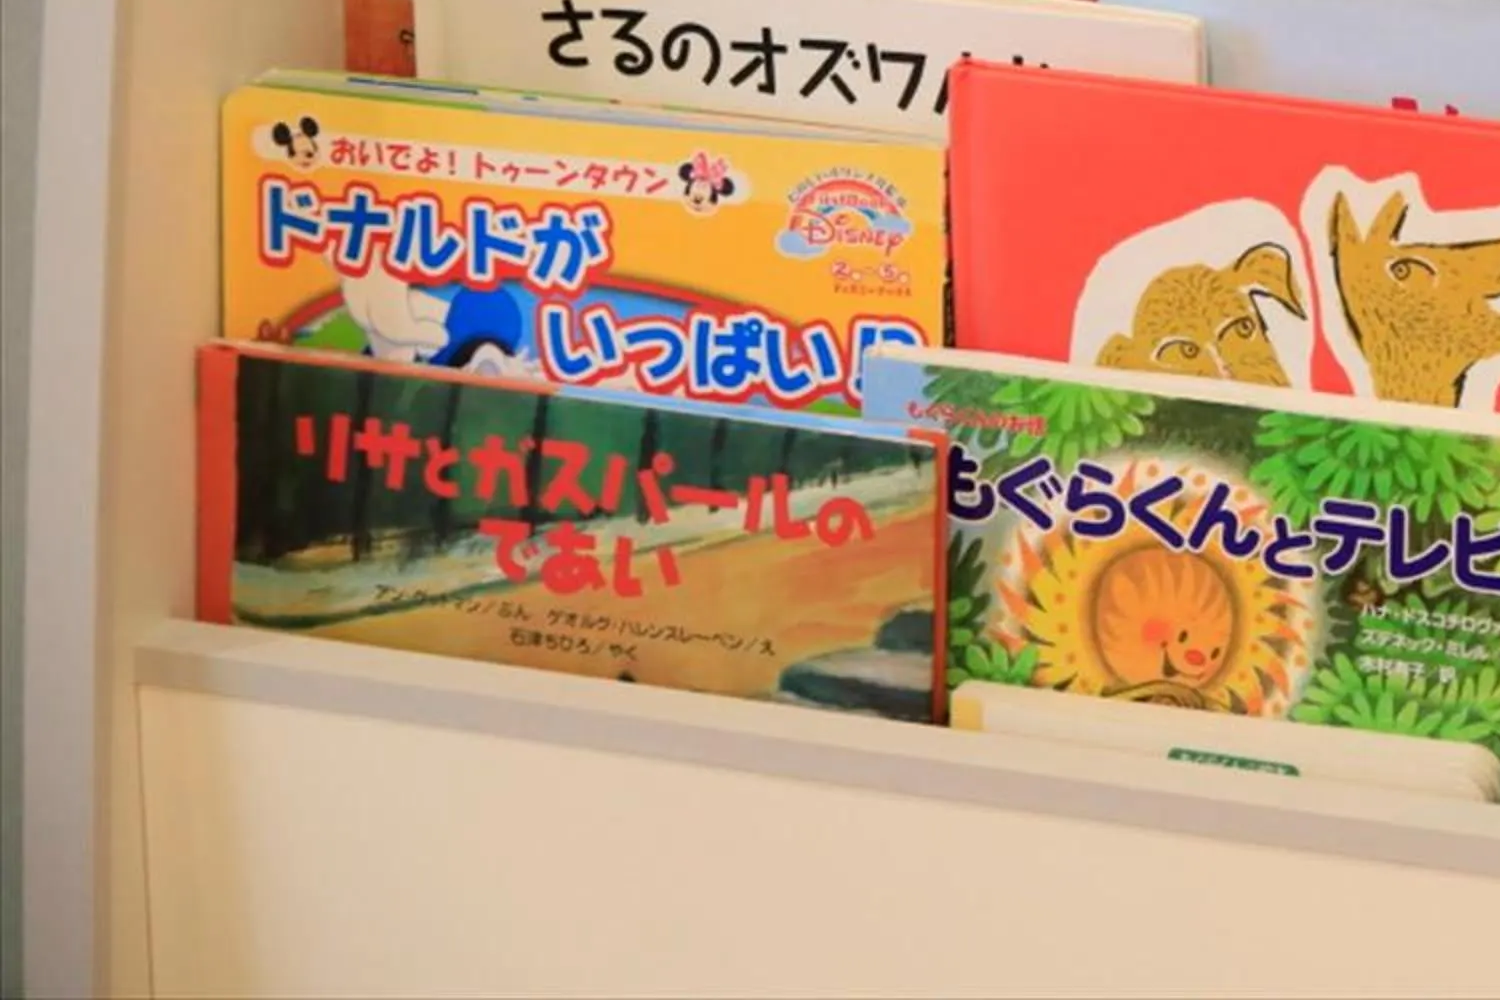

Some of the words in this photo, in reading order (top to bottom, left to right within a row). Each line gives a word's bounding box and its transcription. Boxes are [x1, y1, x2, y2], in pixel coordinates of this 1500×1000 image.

[475, 151, 669, 194] トゥーンタウン
[263, 182, 606, 288] ドナルドが
[295, 415, 875, 547] リサとガスパールの
[478, 518, 682, 598] であい
